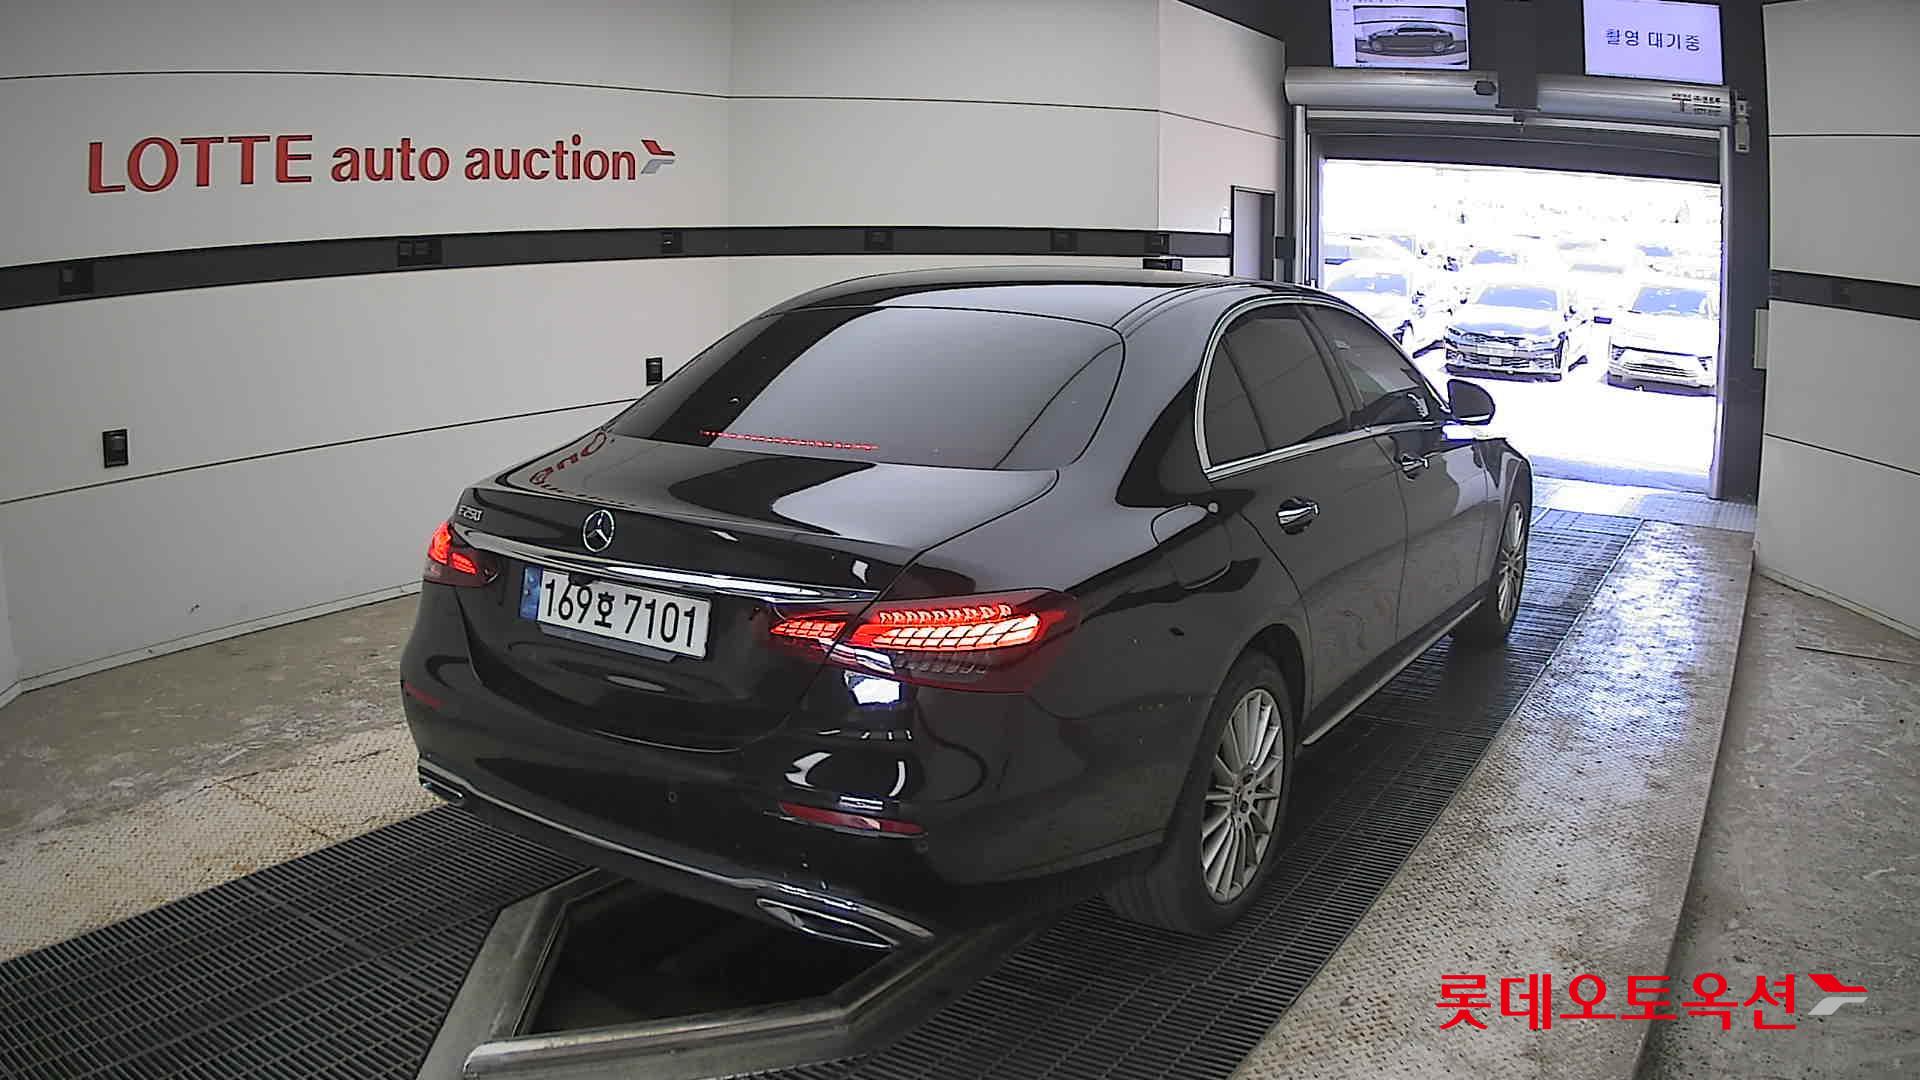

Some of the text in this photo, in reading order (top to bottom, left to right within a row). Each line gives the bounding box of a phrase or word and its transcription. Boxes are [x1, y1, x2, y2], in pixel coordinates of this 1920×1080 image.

[88, 134, 637, 194] LOTTE auto auction
